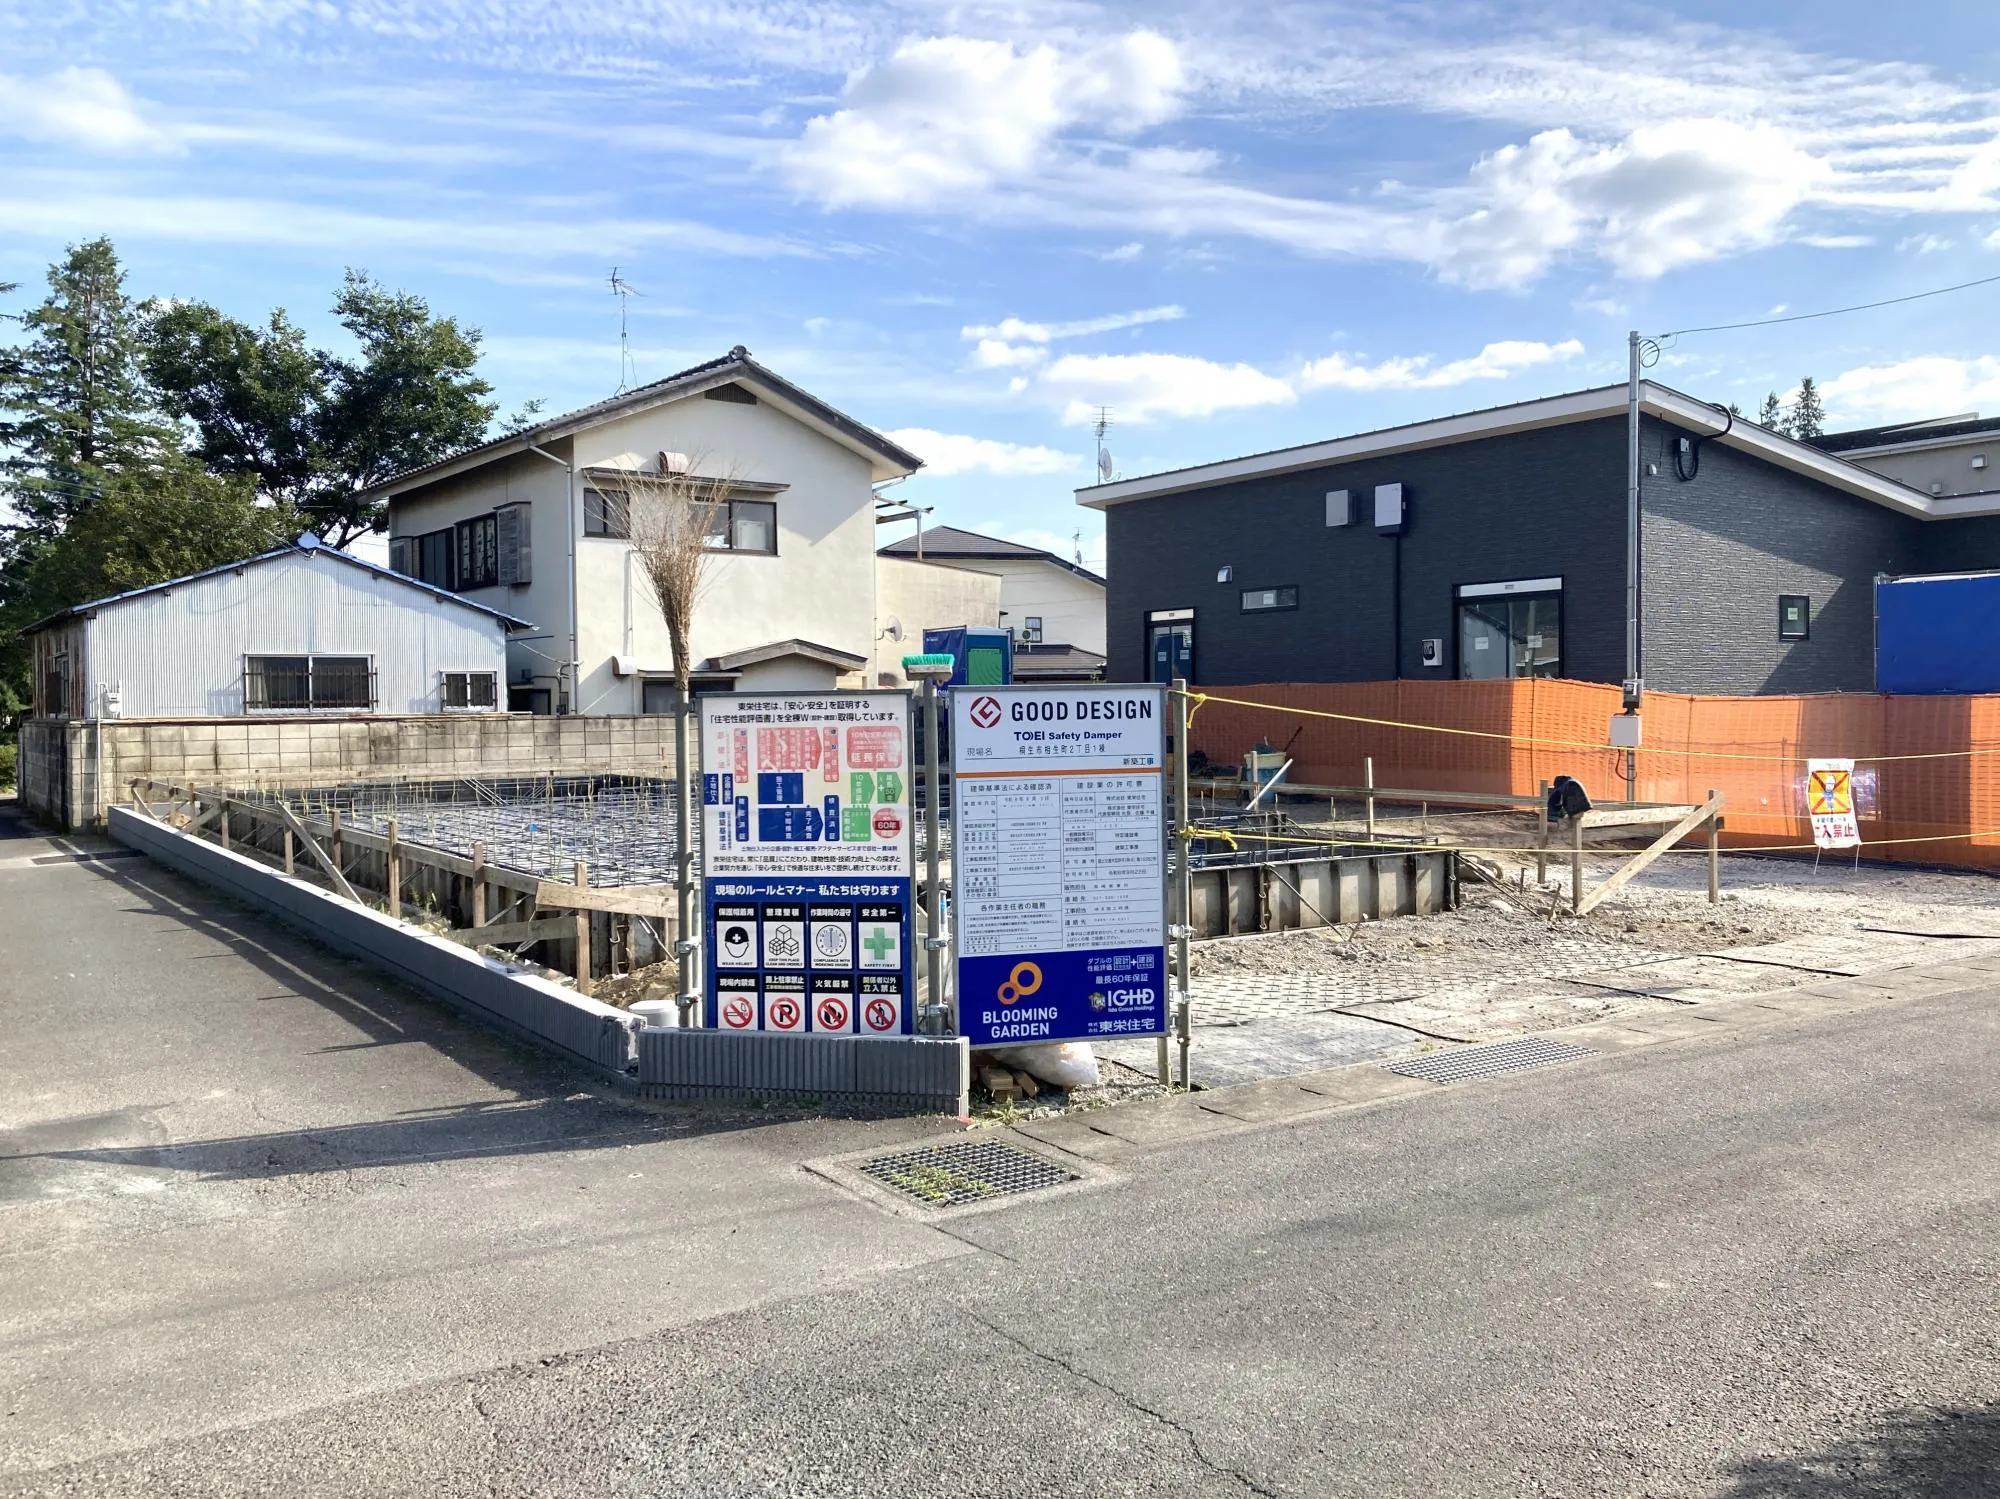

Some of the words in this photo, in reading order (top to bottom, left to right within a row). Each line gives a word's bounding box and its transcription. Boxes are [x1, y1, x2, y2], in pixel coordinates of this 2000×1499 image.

[1011, 701, 1068, 721] GOOD
[1077, 700, 1152, 719] DESIGN
[1048, 732, 1081, 742] Safety
[1083, 731, 1123, 740] Damper
[715, 885, 816, 897] 現場のルールとマナー
[818, 885, 900, 896] 私たちは守ります
[862, 908, 896, 917] 安全第一
[1087, 957, 1113, 965] ダブルの
[815, 980, 849, 988] 火気厳禁
[863, 984, 898, 993] 立入禁止
[982, 1007, 1058, 1024] BLOOMING
[991, 1022, 1050, 1039] GARDEN
[1099, 1018, 1155, 1033] 東栄住宅
